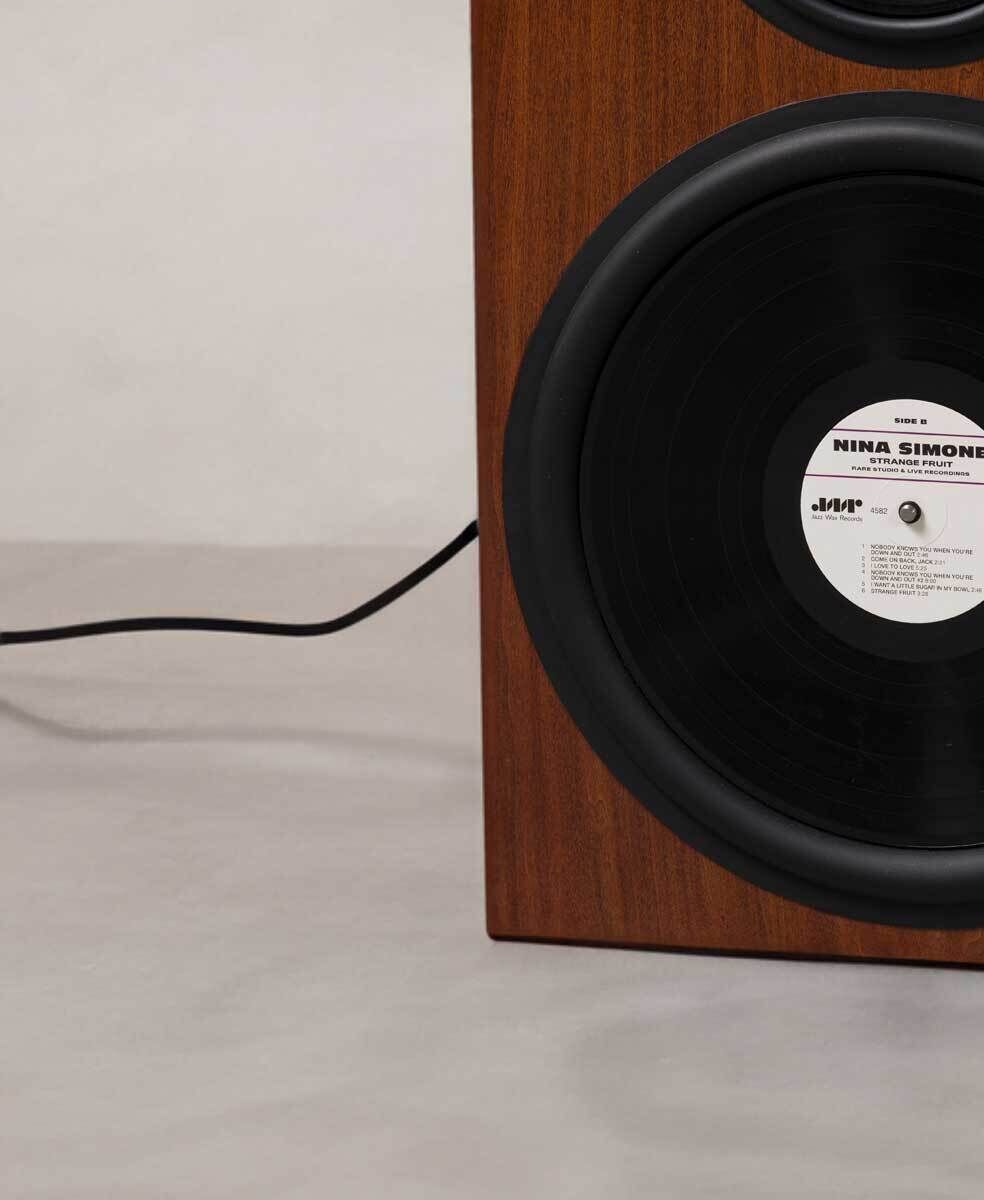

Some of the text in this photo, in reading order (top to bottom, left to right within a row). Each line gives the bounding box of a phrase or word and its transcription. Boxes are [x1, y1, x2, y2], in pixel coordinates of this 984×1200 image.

[834, 439, 891, 454] NINA
[870, 457, 953, 468] STRANGE FRUIT
[870, 507, 888, 515] 4582
